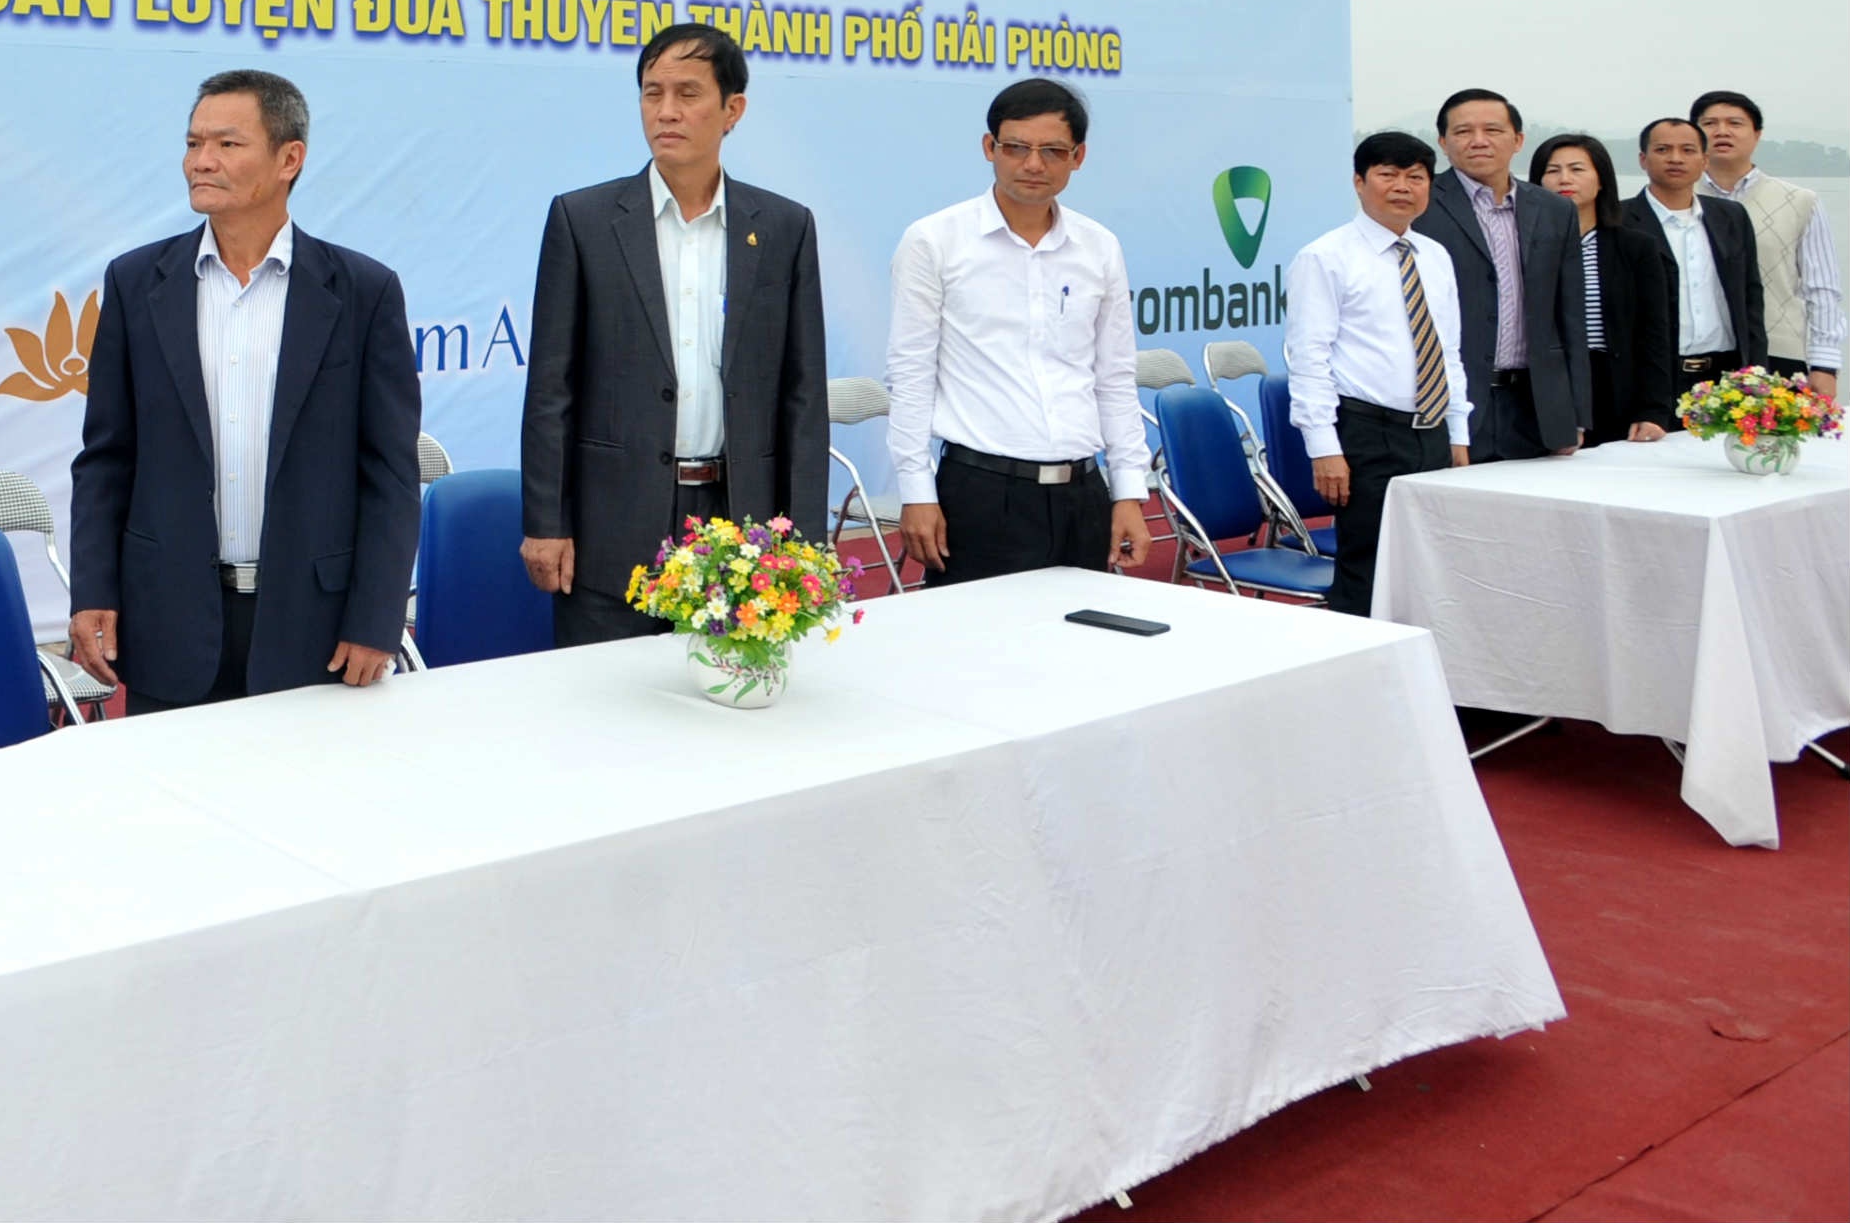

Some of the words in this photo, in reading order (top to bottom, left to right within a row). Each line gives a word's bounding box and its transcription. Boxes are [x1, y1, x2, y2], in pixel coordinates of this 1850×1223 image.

[845, 7, 923, 60] PHỐ
[935, 12, 995, 64] HẢI
[1007, 21, 1122, 70] PHÒNG
[1130, 264, 1288, 336] ombank
